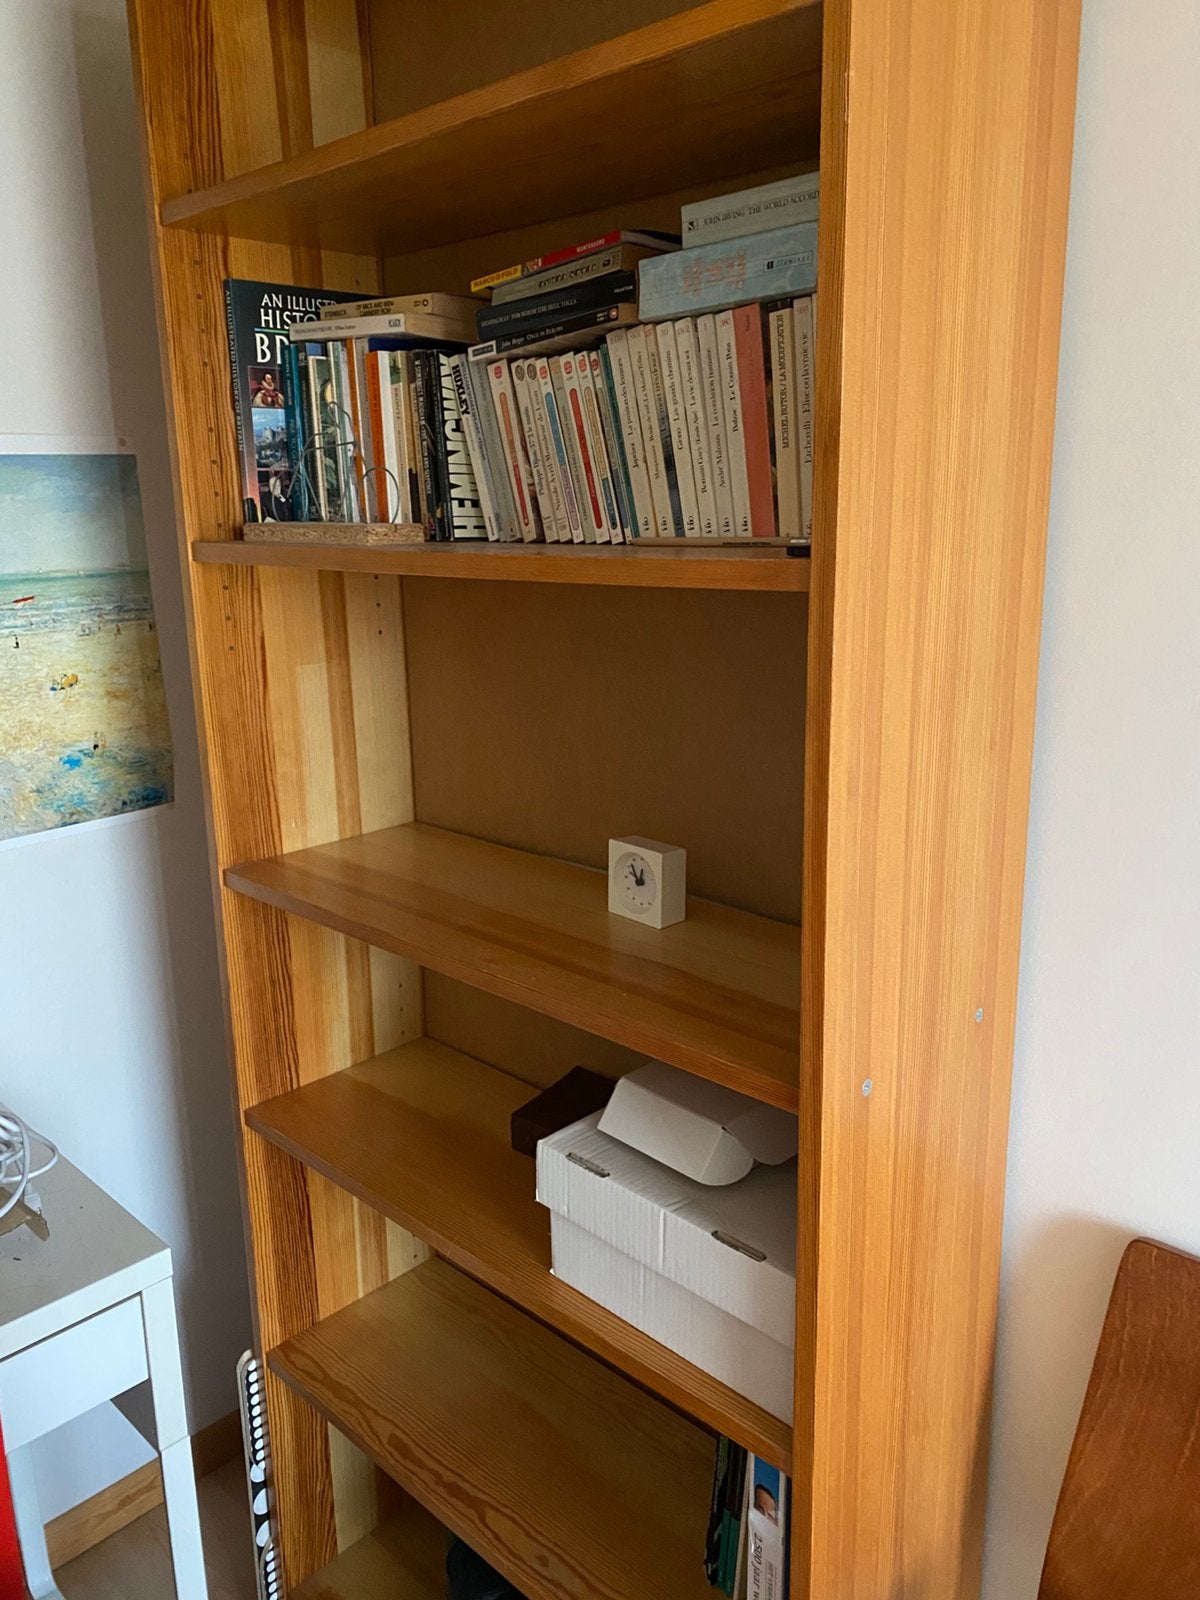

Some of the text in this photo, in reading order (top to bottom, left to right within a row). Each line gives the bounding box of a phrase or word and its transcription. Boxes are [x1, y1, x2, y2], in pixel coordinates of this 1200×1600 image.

[748, 205, 763, 215] THE
[473, 267, 519, 289] MARCO POLO
[226, 291, 231, 303] AN
[261, 294, 282, 308] AN
[227, 306, 236, 361] ILLUSTRATED
[776, 315, 786, 370] MODIFICATION
[664, 351, 674, 381] chemins
[685, 362, 693, 384] devant
[704, 348, 714, 379] humaine
[727, 362, 735, 388] Cousin
[779, 370, 786, 381] LA
[452, 364, 470, 416] HUXLEY
[669, 382, 679, 406] grands
[689, 396, 697, 407] La
[708, 380, 718, 415] condition
[729, 390, 736, 400] Le
[780, 388, 788, 415] BUTOR
[234, 402, 240, 412] OF
[712, 416, 719, 427] La
[781, 416, 789, 448] MICHEL
[539, 424, 552, 463] Monsieur
[675, 427, 684, 450] Giono
[696, 446, 706, 464] Gary
[547, 463, 556, 484] Avril
[698, 464, 708, 492] Romain
[551, 485, 562, 511] Nicole
[751, 1562, 761, 1590] jaar
